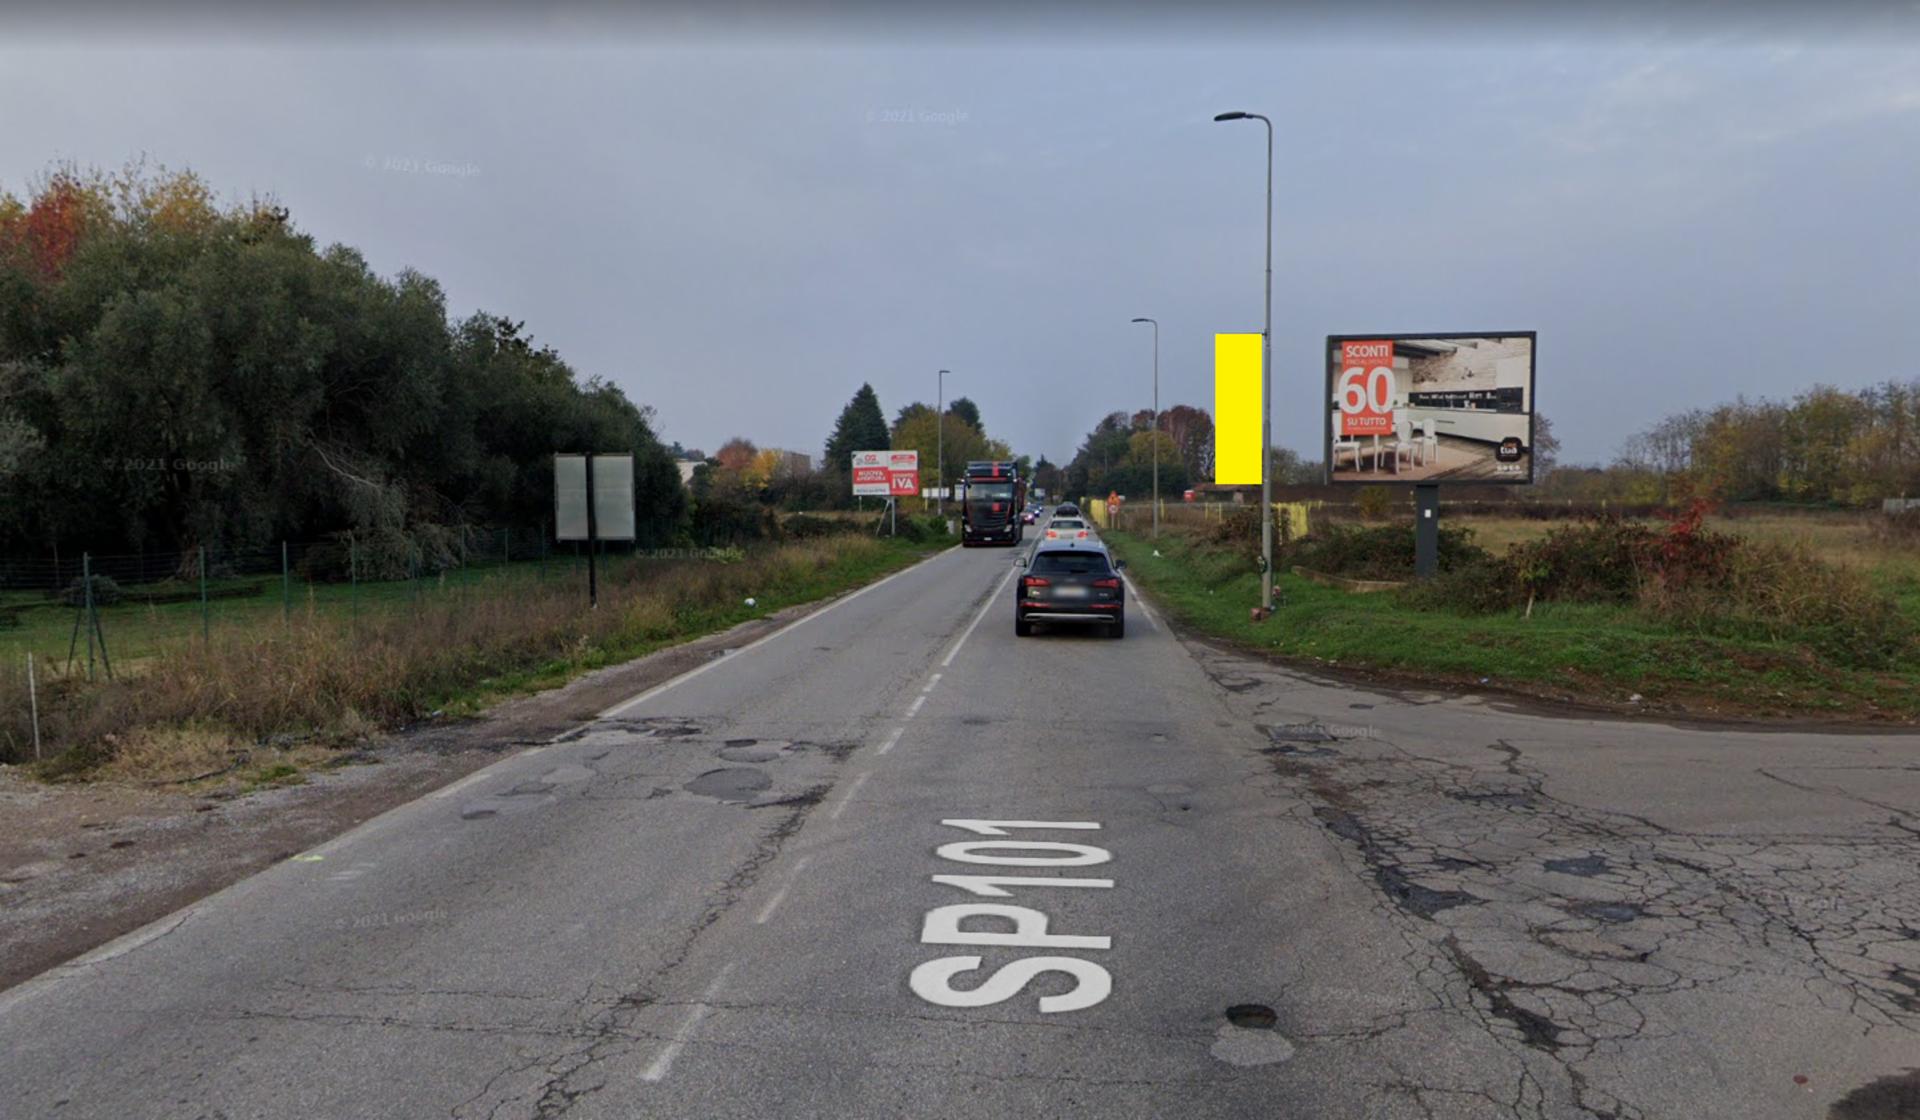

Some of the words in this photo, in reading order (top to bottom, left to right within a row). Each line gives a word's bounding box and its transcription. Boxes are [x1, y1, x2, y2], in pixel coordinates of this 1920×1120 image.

[1345, 345, 1389, 358] SCONTI
[1338, 366, 1396, 415] 60
[1347, 417, 1358, 427] SU
[1360, 417, 1387, 427] TUTTO
[893, 477, 914, 489] IVA
